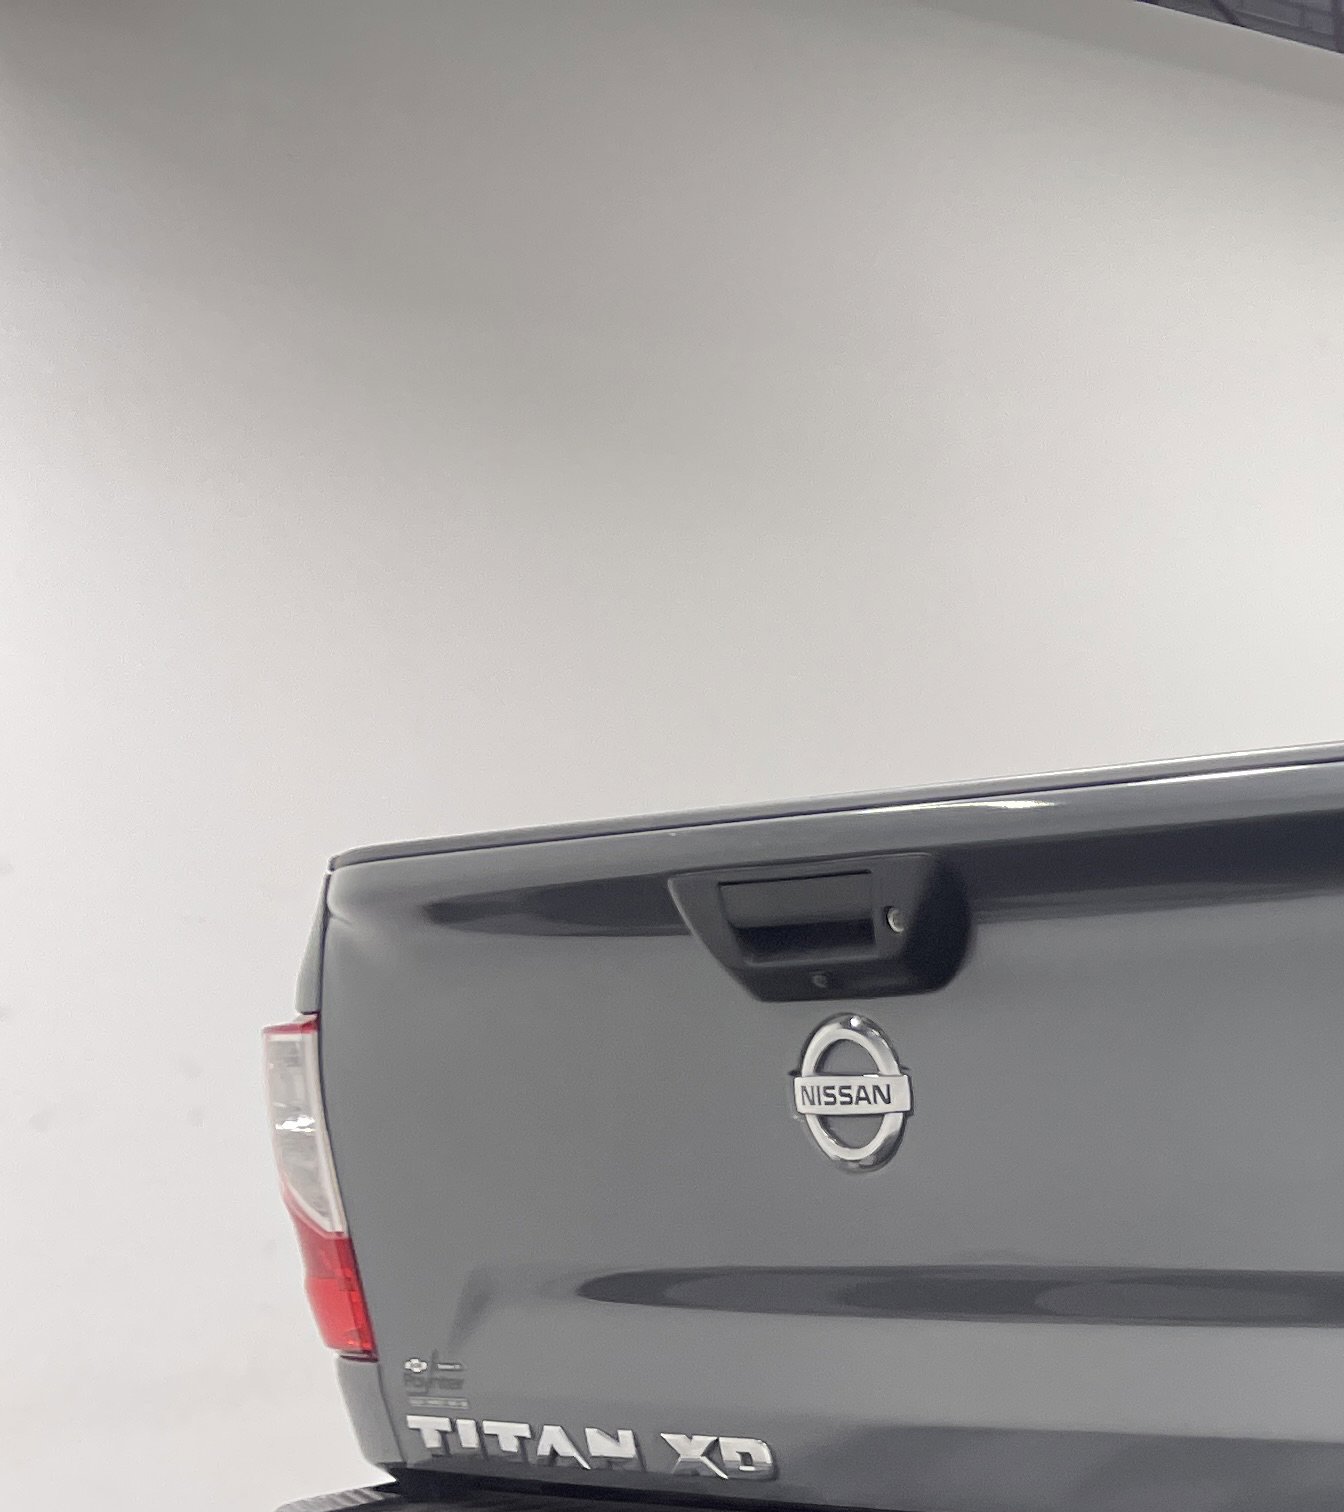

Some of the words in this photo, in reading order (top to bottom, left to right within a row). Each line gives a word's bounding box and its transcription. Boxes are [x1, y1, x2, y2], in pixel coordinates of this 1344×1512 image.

[800, 1083, 893, 1107] NISSAN
[405, 1414, 645, 1471] TITAN
[660, 1432, 778, 1480] XD
